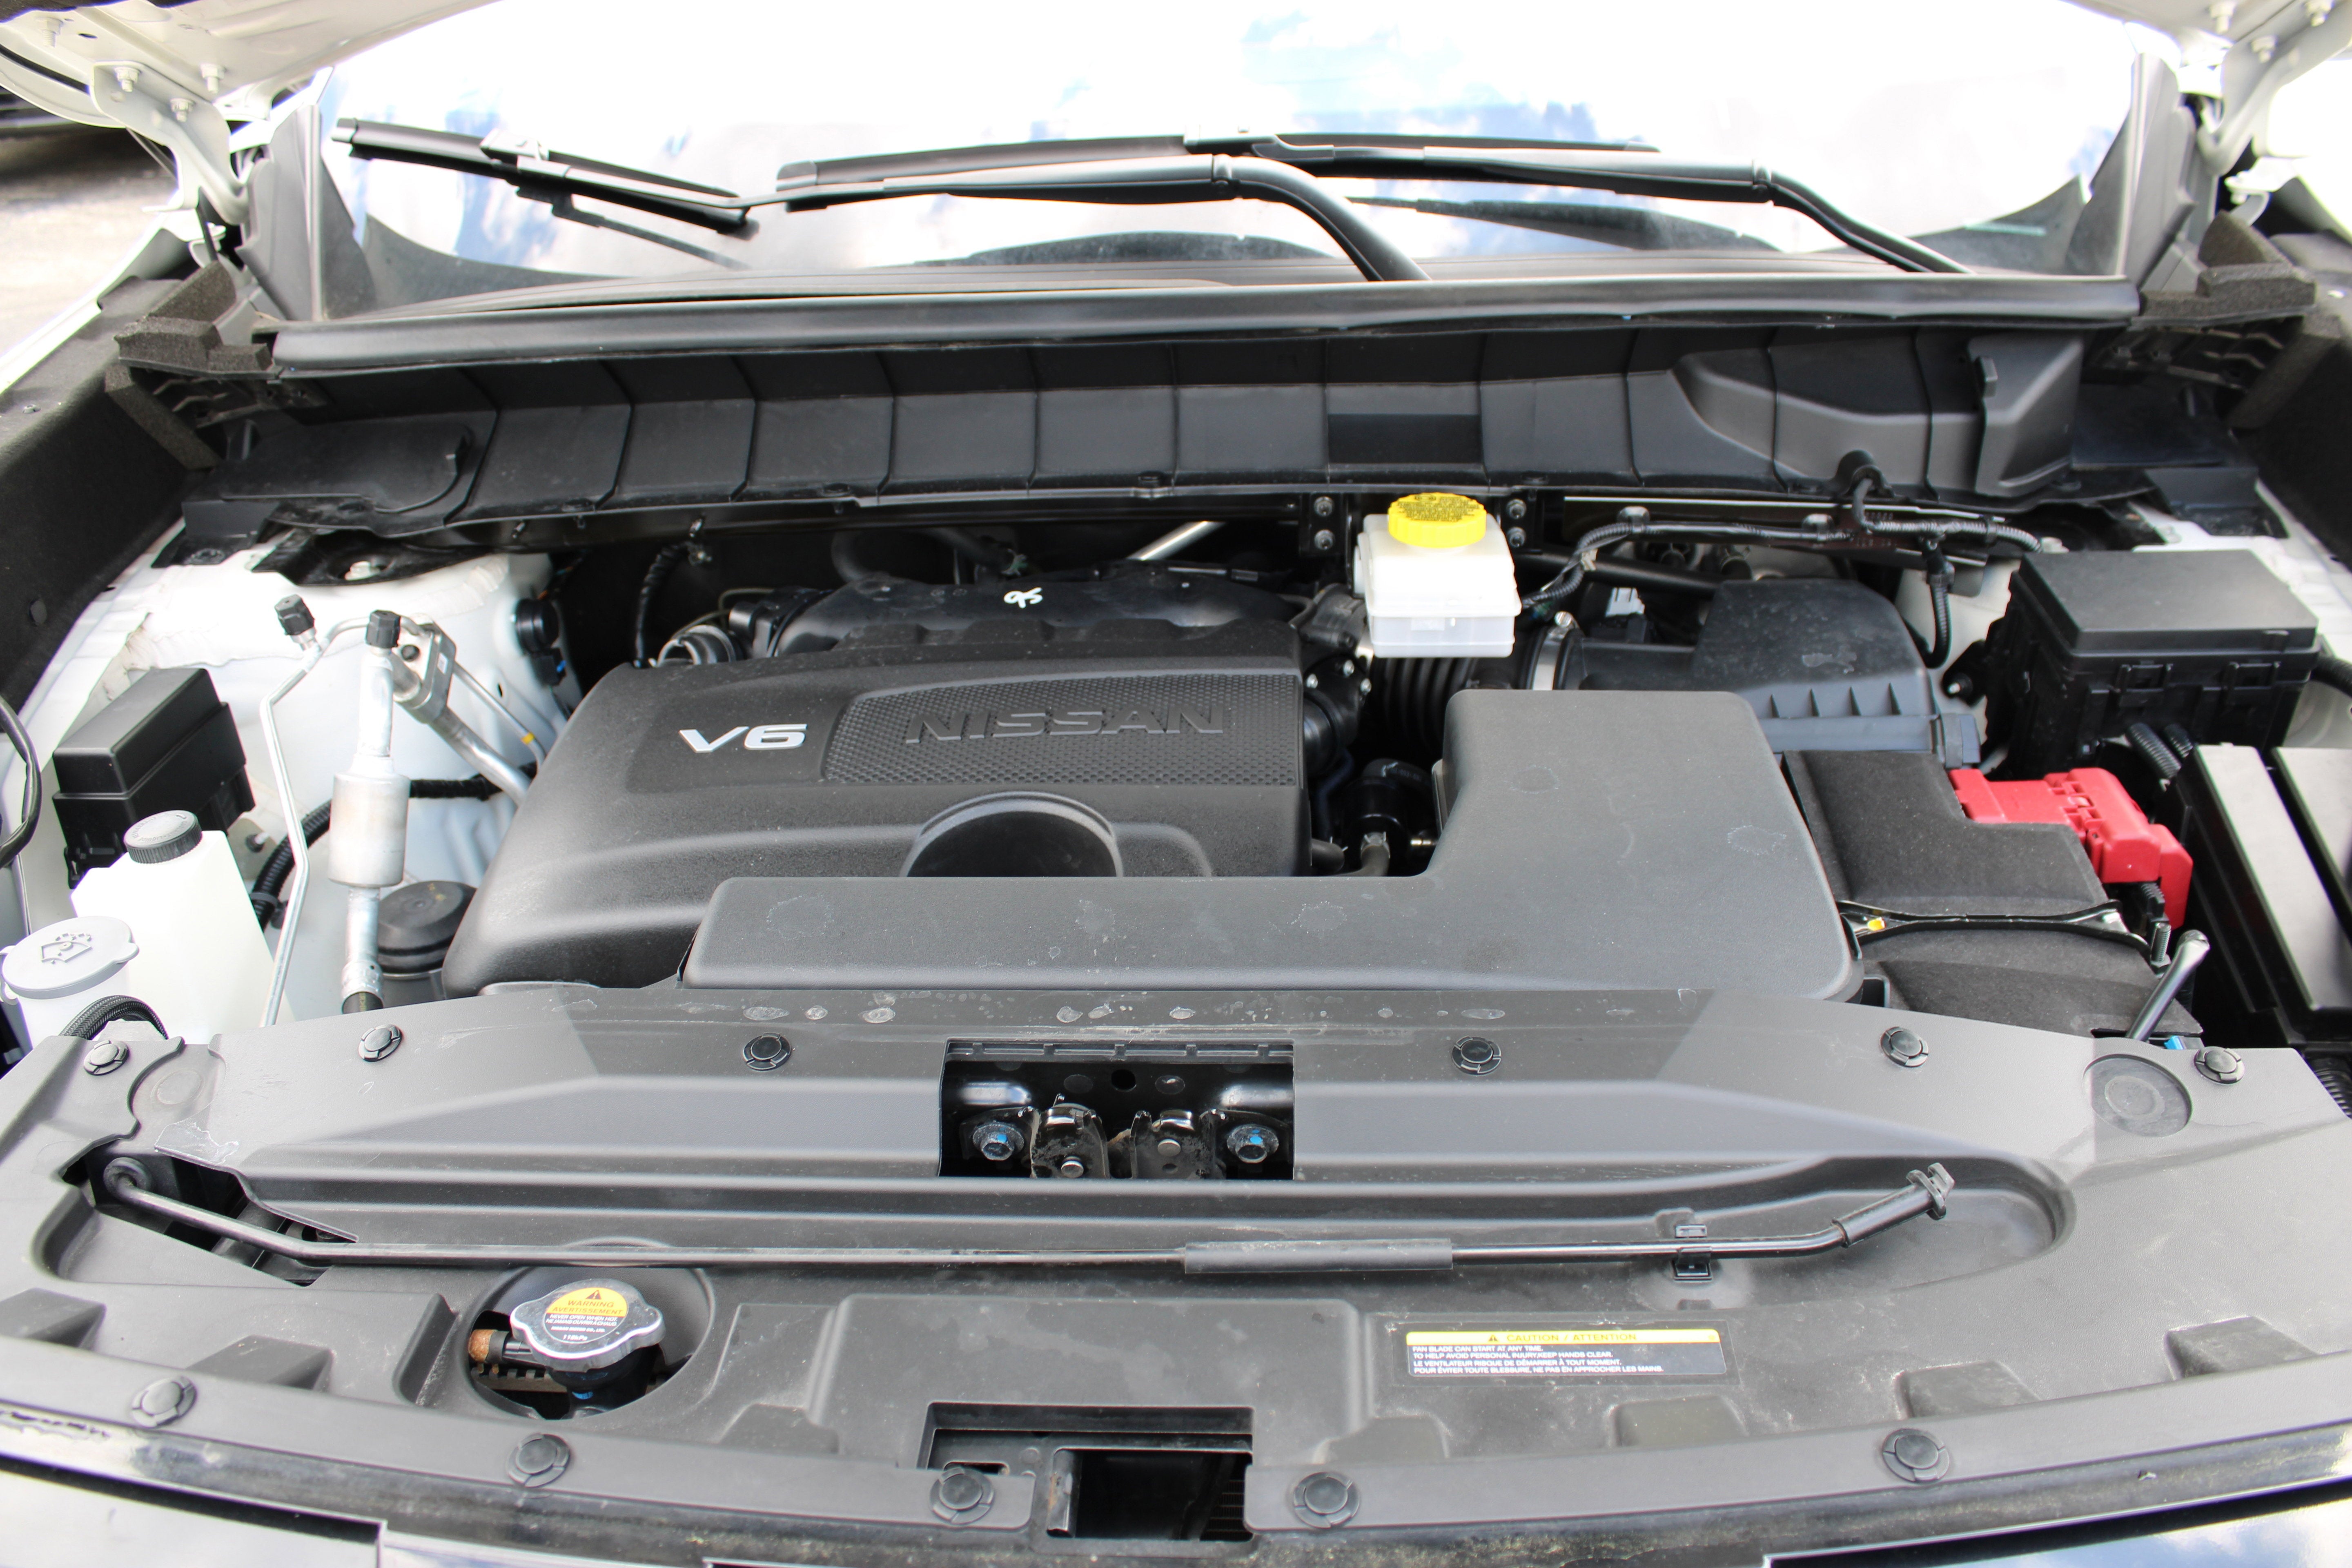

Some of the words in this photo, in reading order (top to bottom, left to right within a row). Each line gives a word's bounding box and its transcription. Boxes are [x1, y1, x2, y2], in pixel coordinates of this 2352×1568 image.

[678, 723, 808, 754] V6
[905, 702, 1224, 745] NISSAN
[568, 1300, 615, 1308] WARNING
